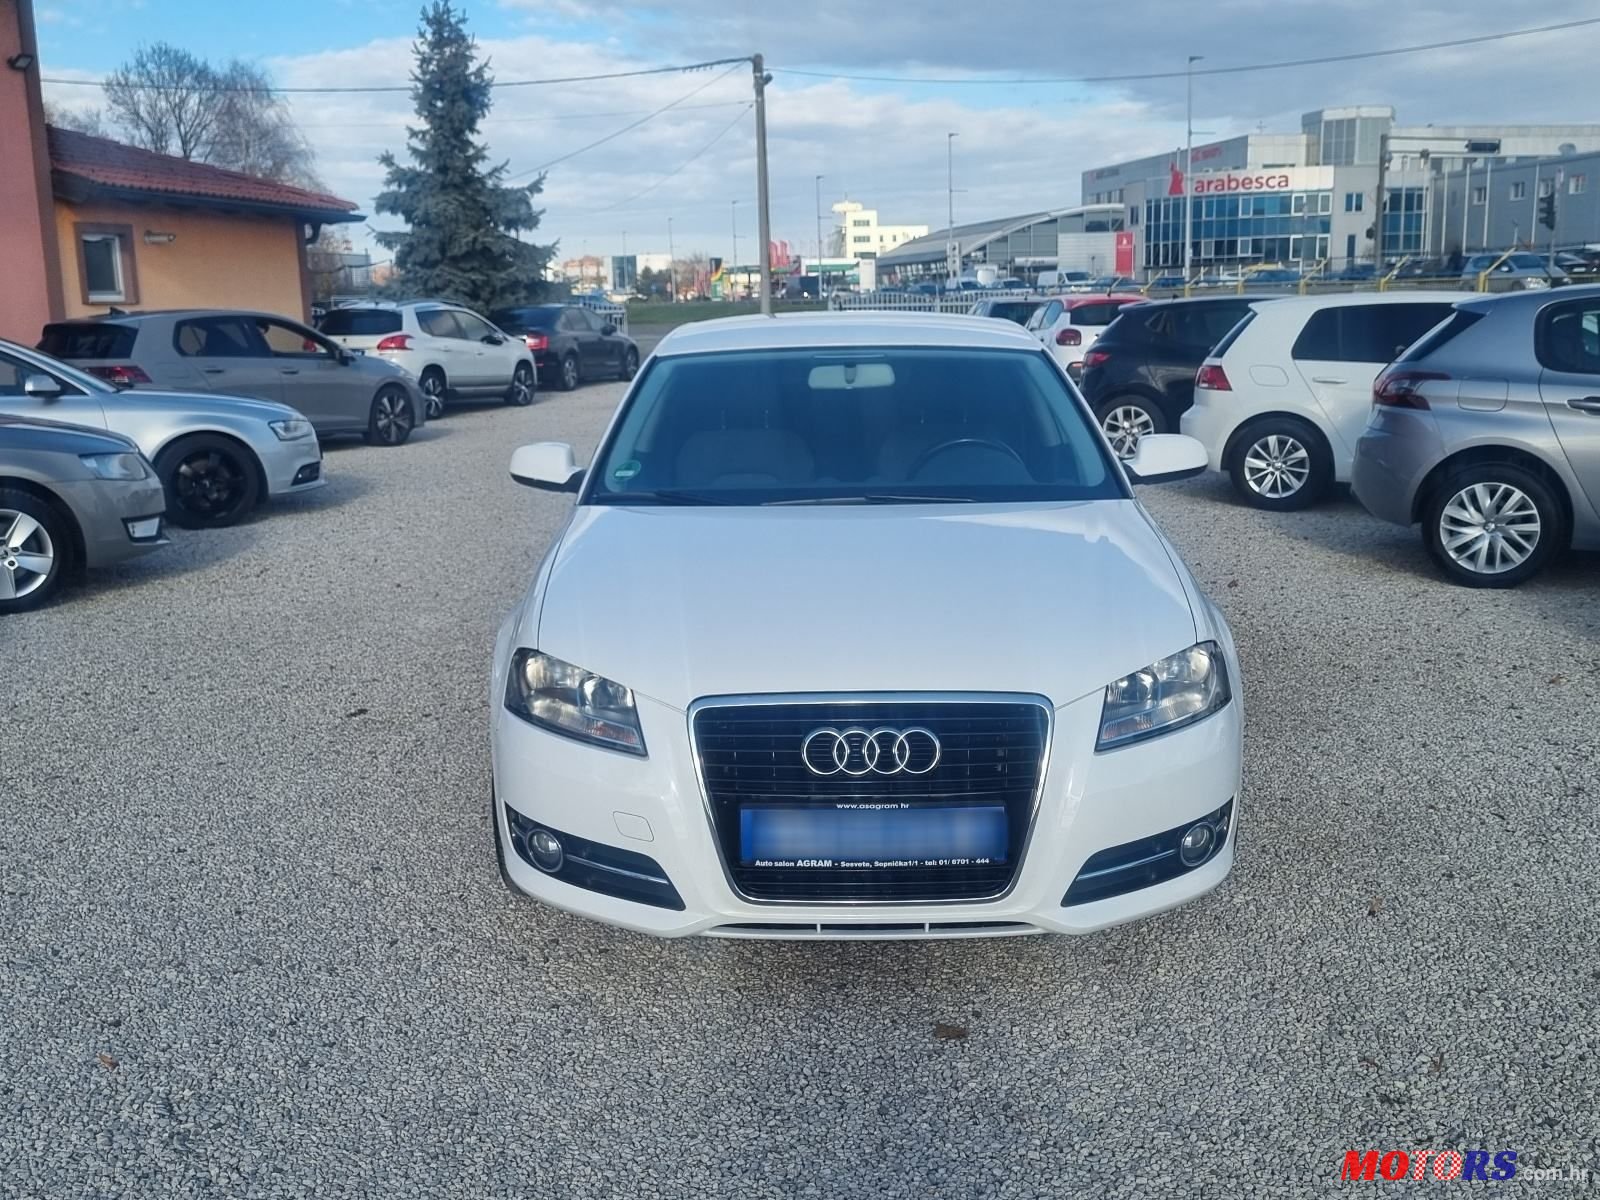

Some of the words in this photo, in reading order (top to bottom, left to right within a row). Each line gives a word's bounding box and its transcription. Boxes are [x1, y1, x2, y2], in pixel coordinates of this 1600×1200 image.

[1194, 174, 1289, 193] arabesca
[755, 859, 773, 867] Auto
[796, 859, 833, 868] AGRAM
